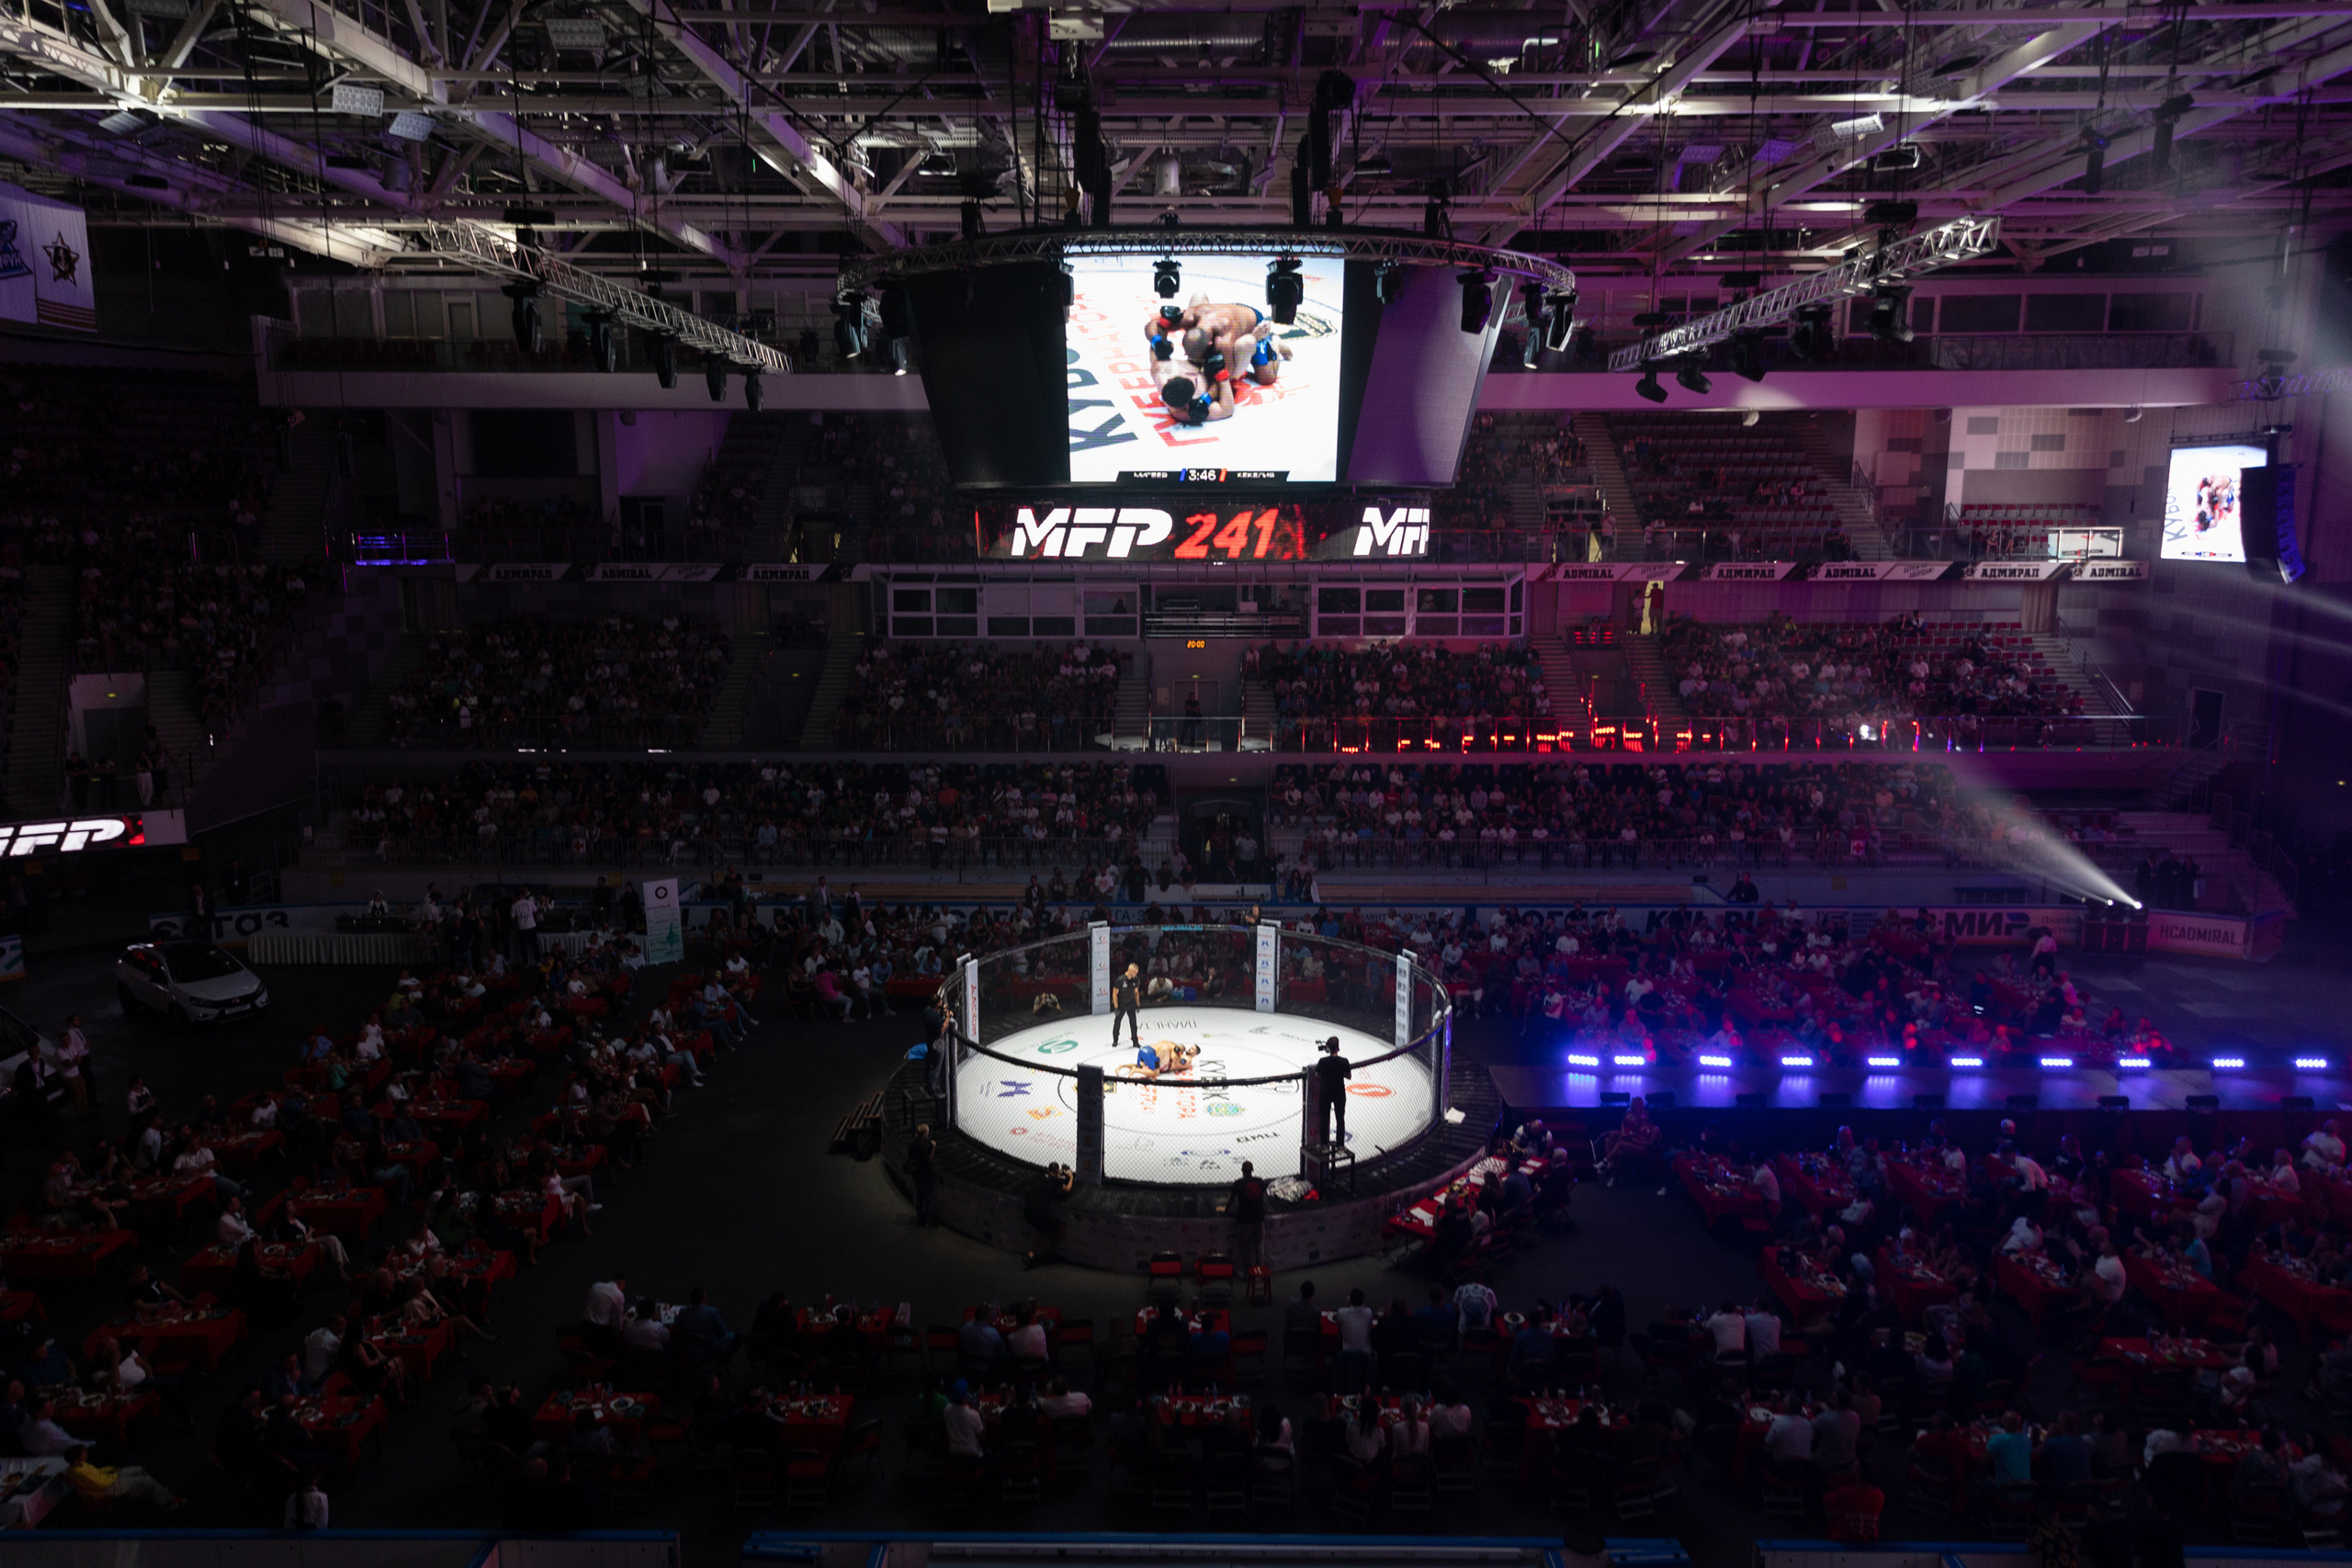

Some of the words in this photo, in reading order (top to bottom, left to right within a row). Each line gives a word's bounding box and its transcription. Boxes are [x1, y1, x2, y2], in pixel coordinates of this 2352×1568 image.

[1188, 469, 1216, 481] 3:46
[1011, 508, 1173, 558] MFP
[1174, 509, 1279, 559] 241
[602, 569, 651, 580] ADMIRAL
[1563, 569, 1614, 579] ADMIRAL
[1716, 569, 1775, 579] АДМИРАЛ
[1825, 568, 1876, 579] ADMIRAL
[1981, 568, 2040, 578] АДМИРАЛ
[2089, 567, 2142, 578] ADMIRAL
[1186, 640, 1205, 649] 20:00
[1944, 910, 2030, 937] МИР
